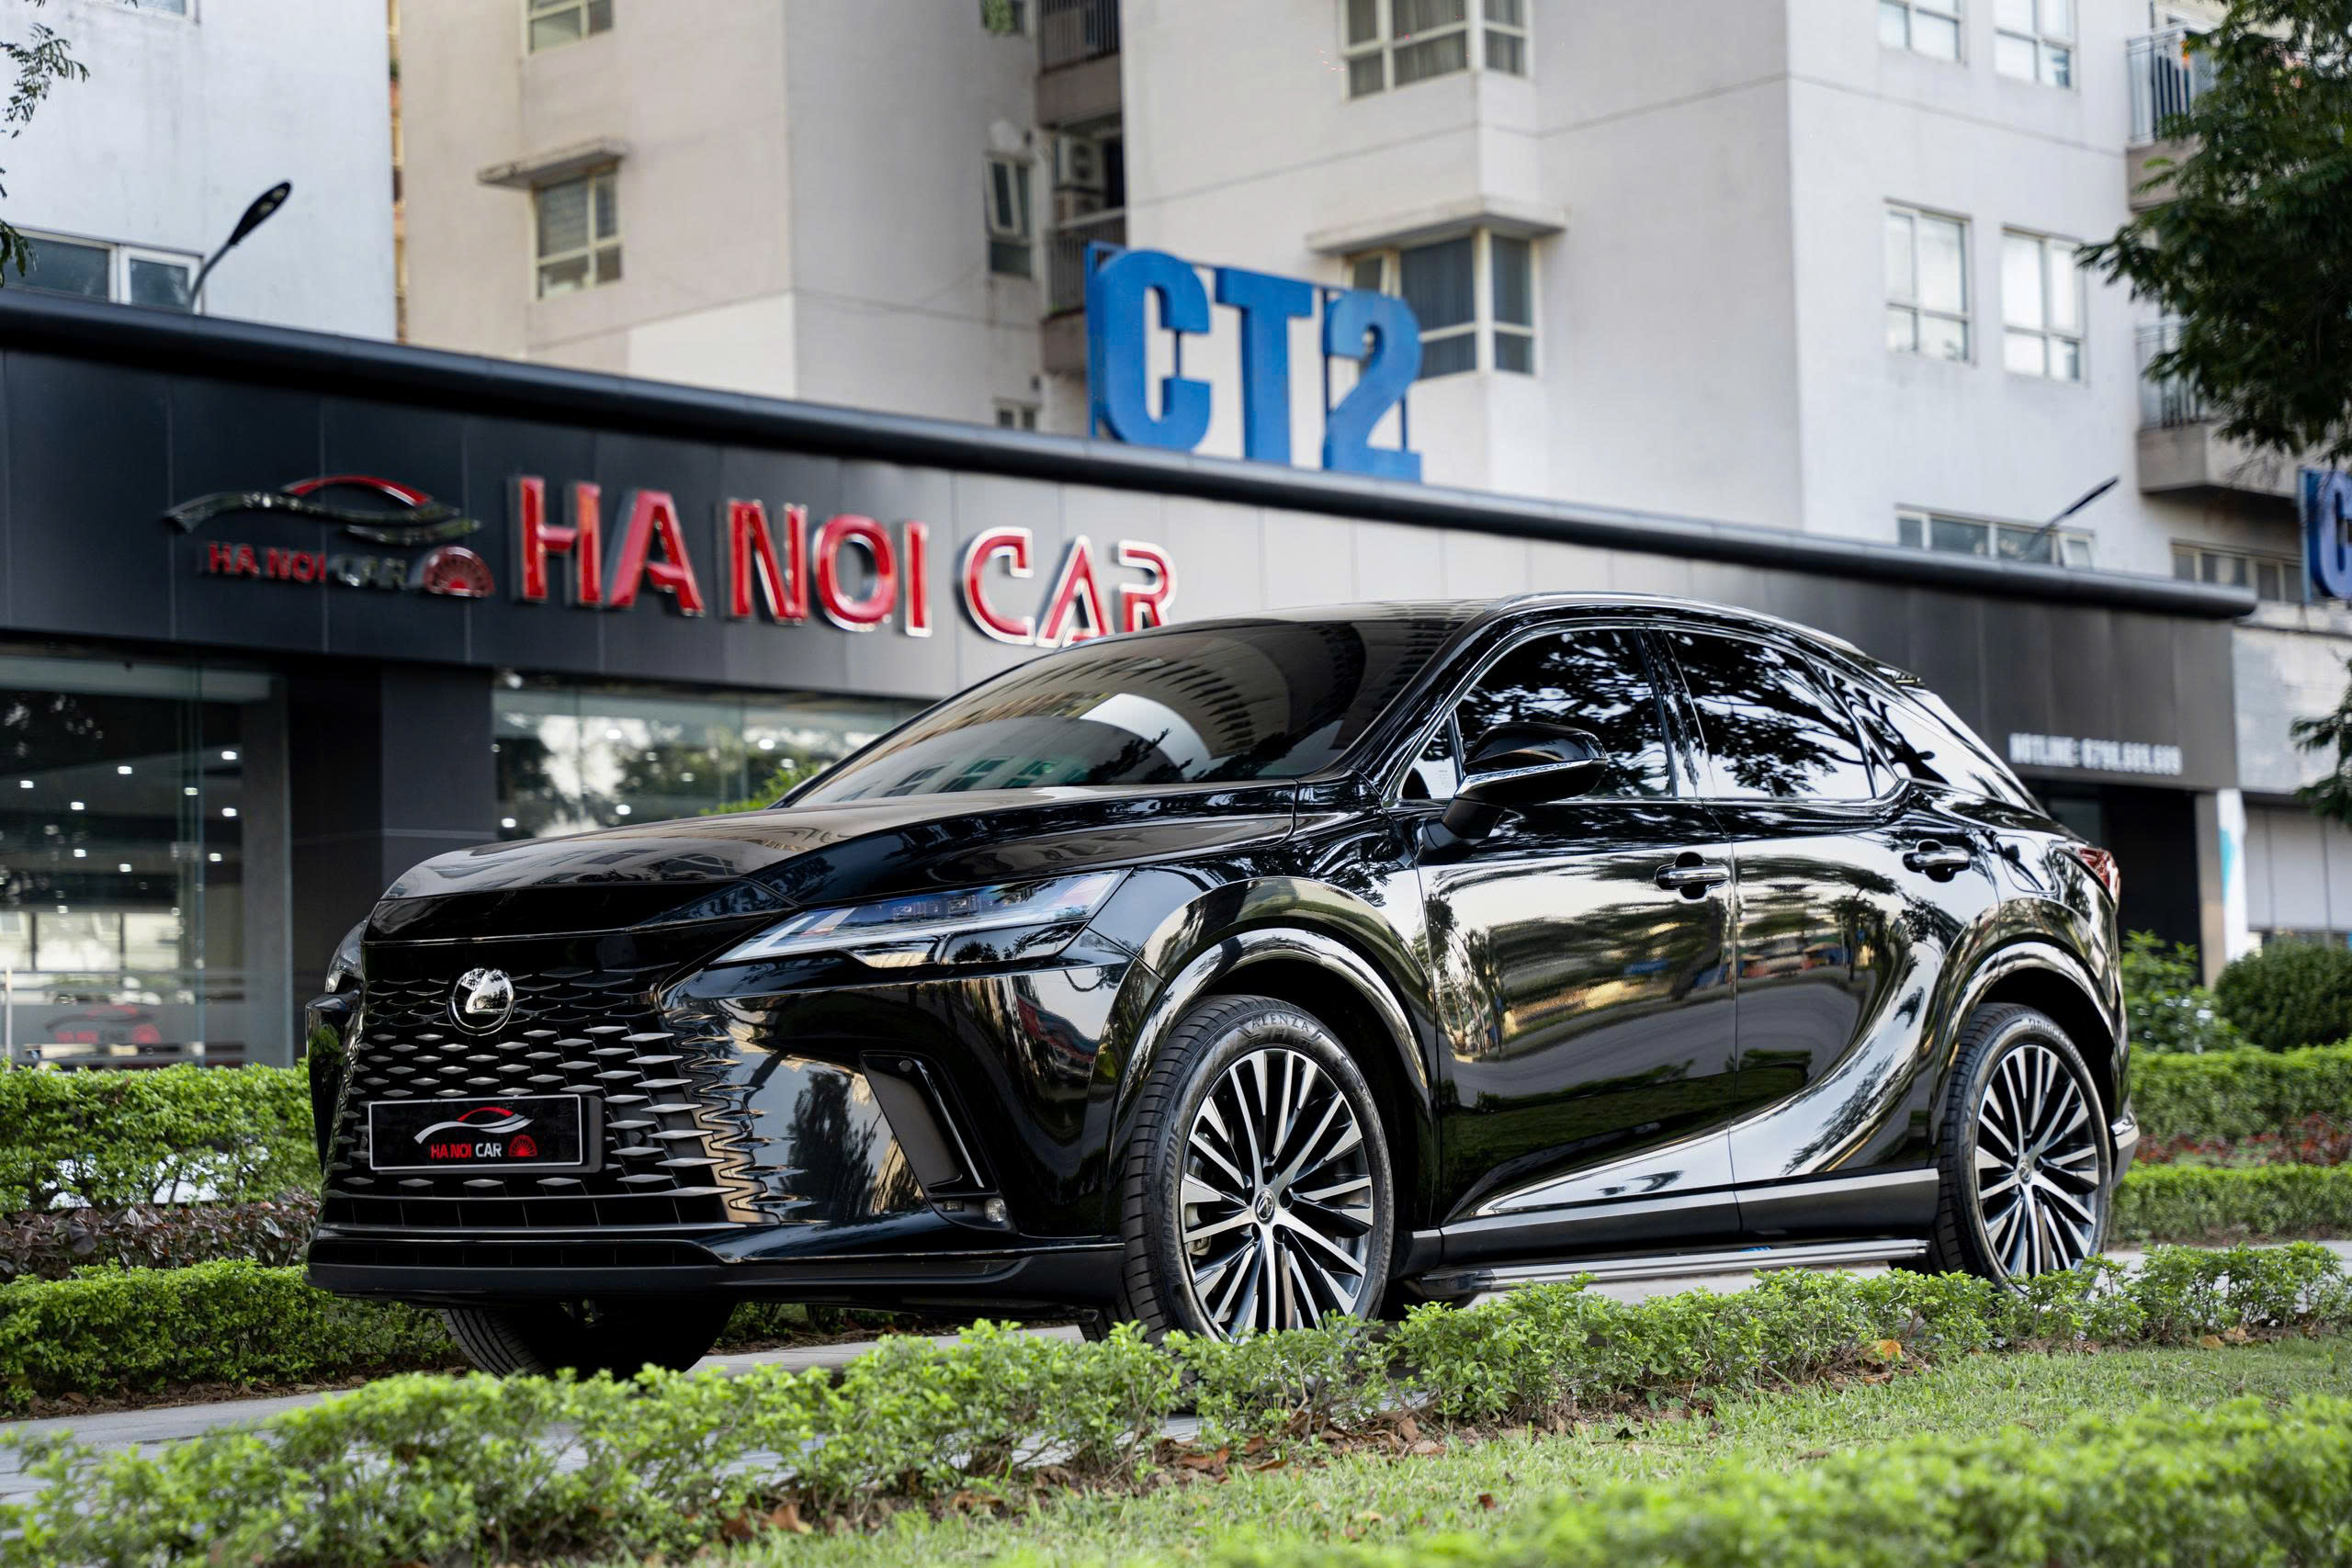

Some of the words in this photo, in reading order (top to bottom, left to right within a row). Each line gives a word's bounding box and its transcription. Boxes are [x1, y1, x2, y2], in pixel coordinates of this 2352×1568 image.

[1088, 250, 1422, 483] CT2
[961, 525, 1177, 648] CAR
[1251, 1013, 1309, 1032] ALENZA
[475, 1143, 503, 1157] CAR
[1161, 1122, 1185, 1285] BRIDGESTONE
